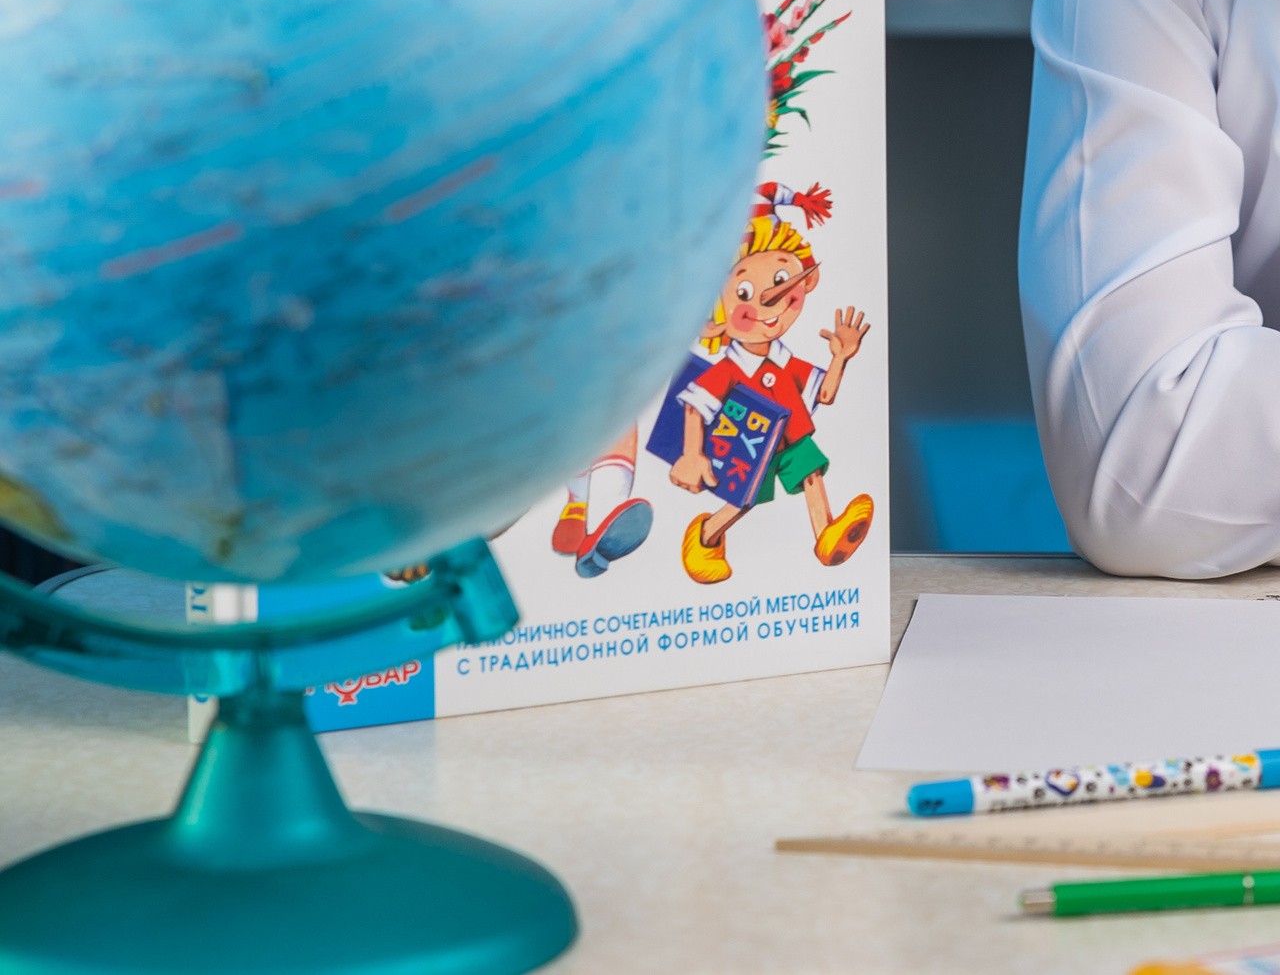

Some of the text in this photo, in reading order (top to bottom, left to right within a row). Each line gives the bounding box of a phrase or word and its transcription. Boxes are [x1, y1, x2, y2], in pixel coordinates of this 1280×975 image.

[456, 588, 860, 651] ОНИЧНОЕ СОЧЕТАНИЕ НОВОЙ МЕТОДИКИ
[457, 612, 860, 675] С ТРАДИЦИОННОЙ ФОРМОЙ ОБУЧЕНИЯ
